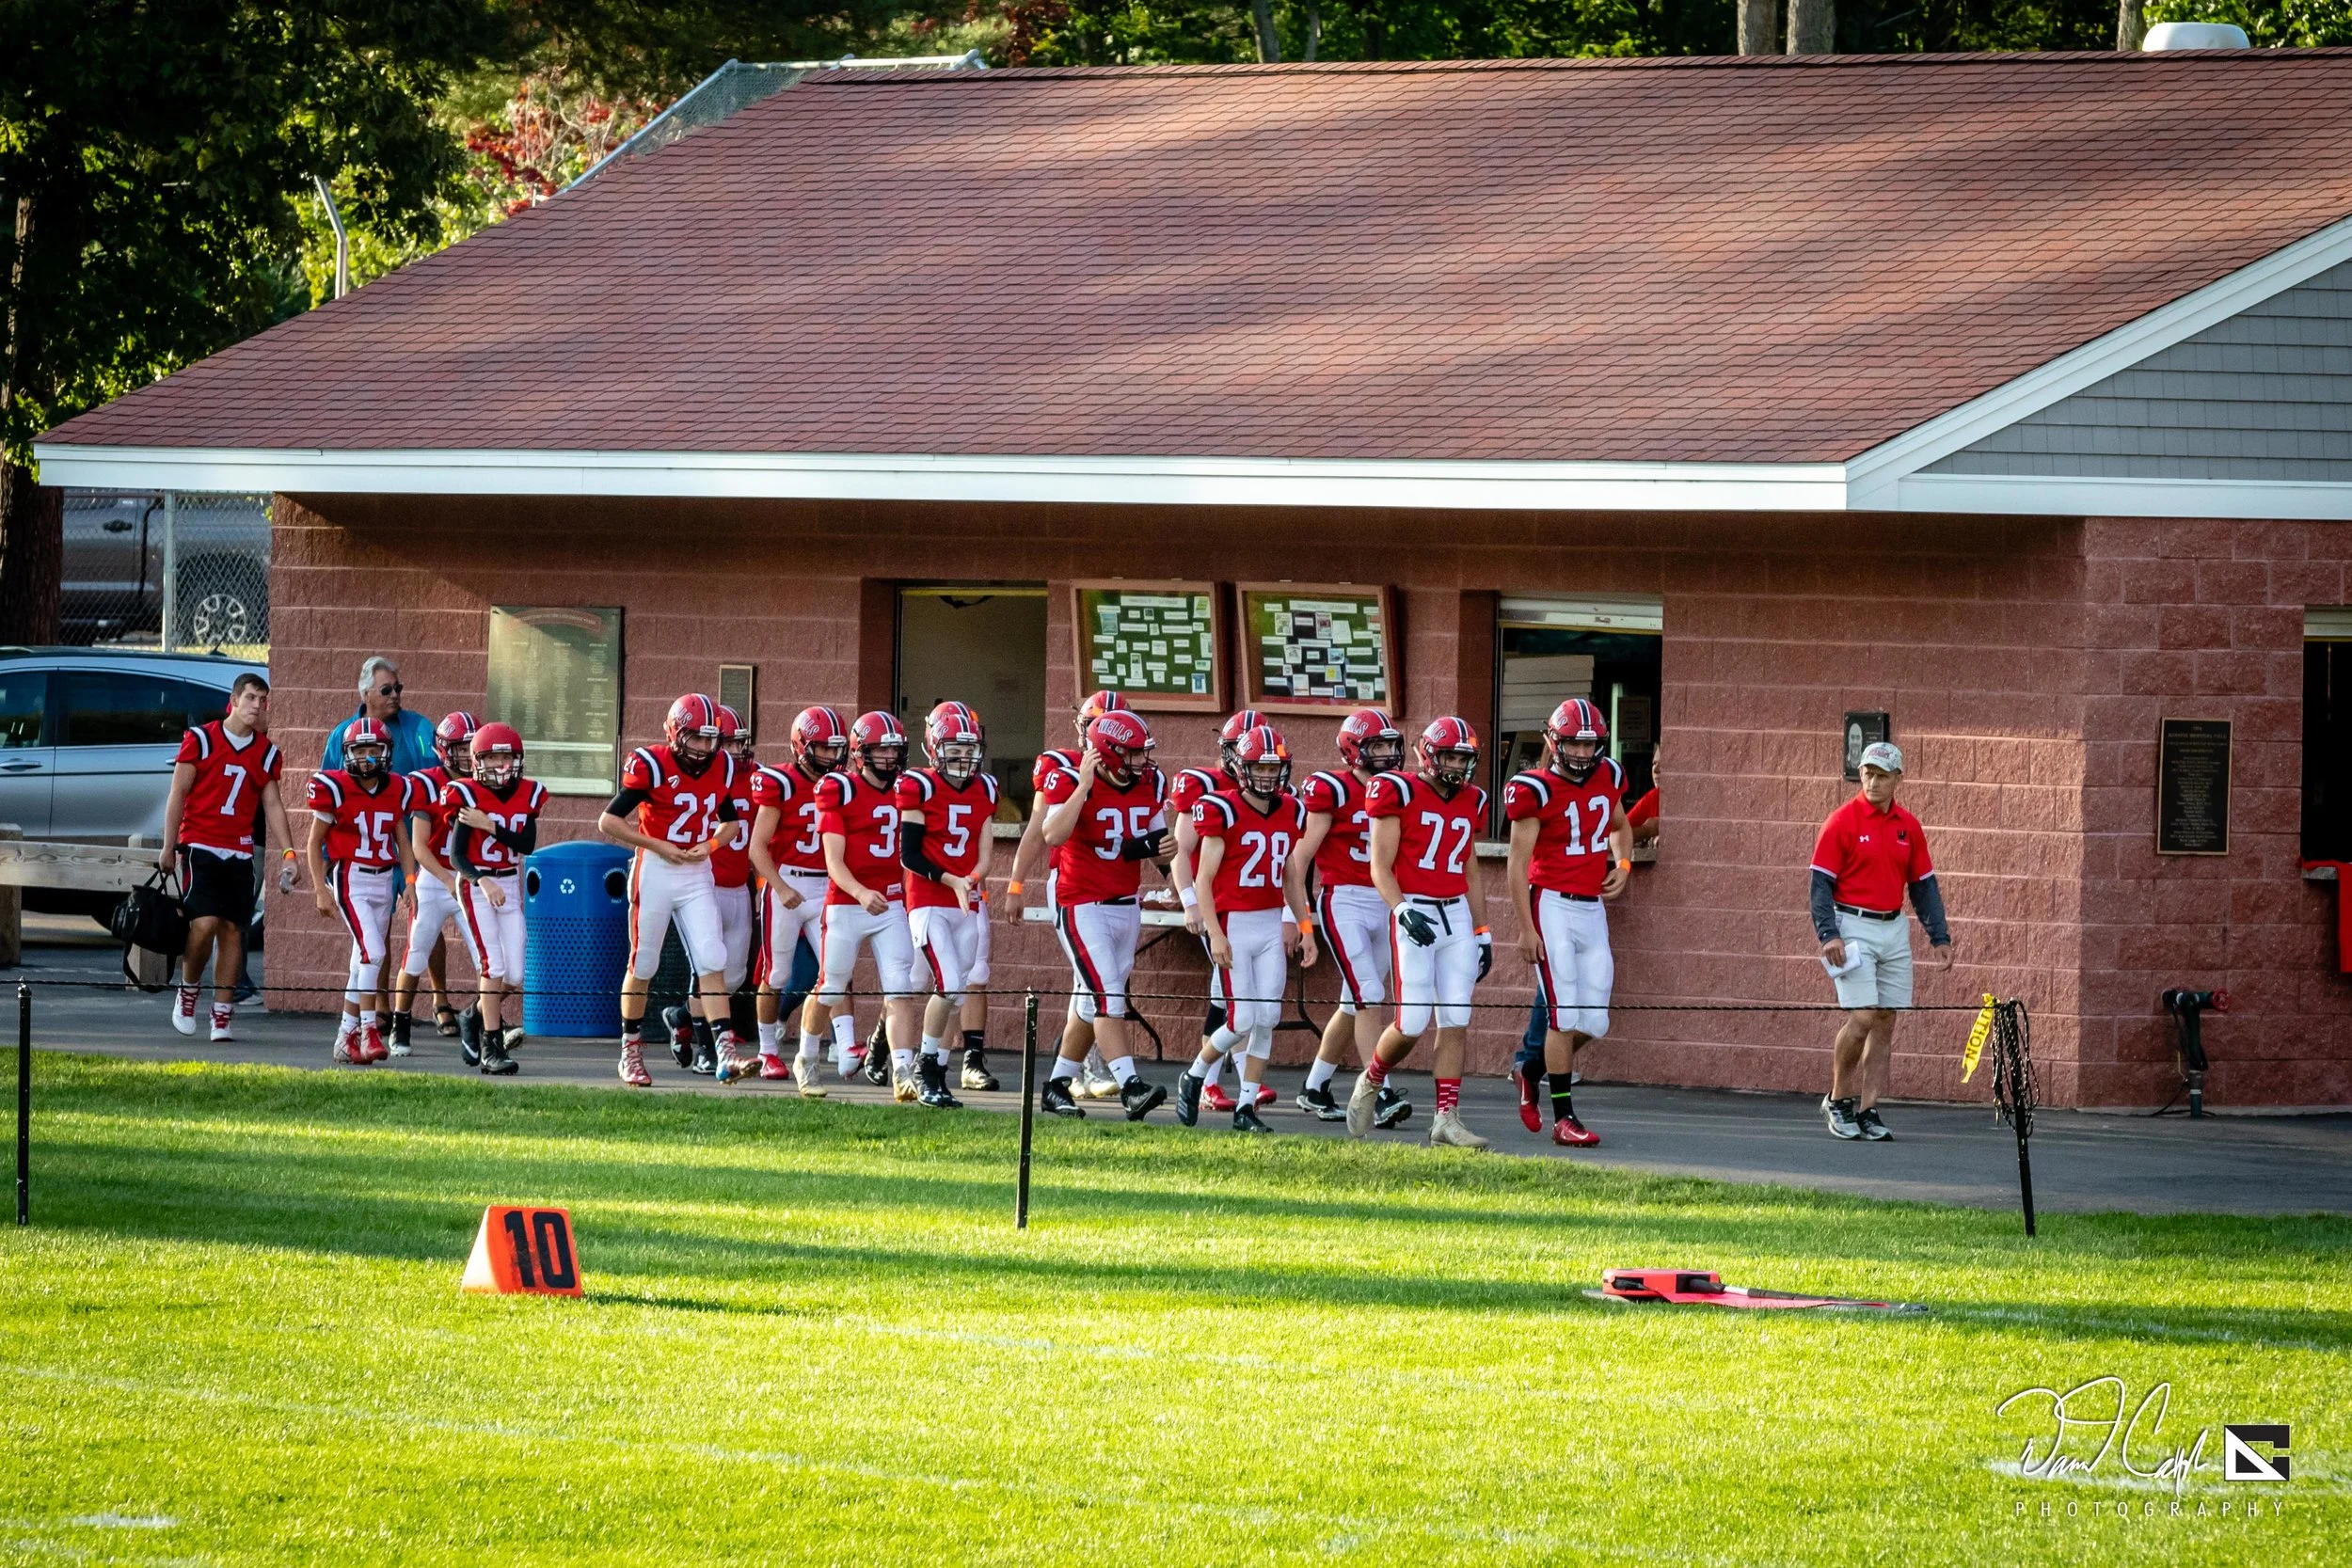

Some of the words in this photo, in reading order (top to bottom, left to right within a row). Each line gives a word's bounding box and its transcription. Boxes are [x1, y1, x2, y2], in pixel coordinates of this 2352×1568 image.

[1098, 718, 1134, 743] WELLS
[220, 763, 246, 816] 7
[353, 810, 394, 862] 15
[666, 792, 717, 843] 21
[868, 804, 898, 858] 3
[943, 803, 972, 857] 5
[1094, 806, 1151, 861] 35
[1418, 810, 1471, 875] 72
[1564, 794, 1610, 856] 12
[1238, 831, 1290, 889] 28
[503, 1210, 576, 1290] 10
